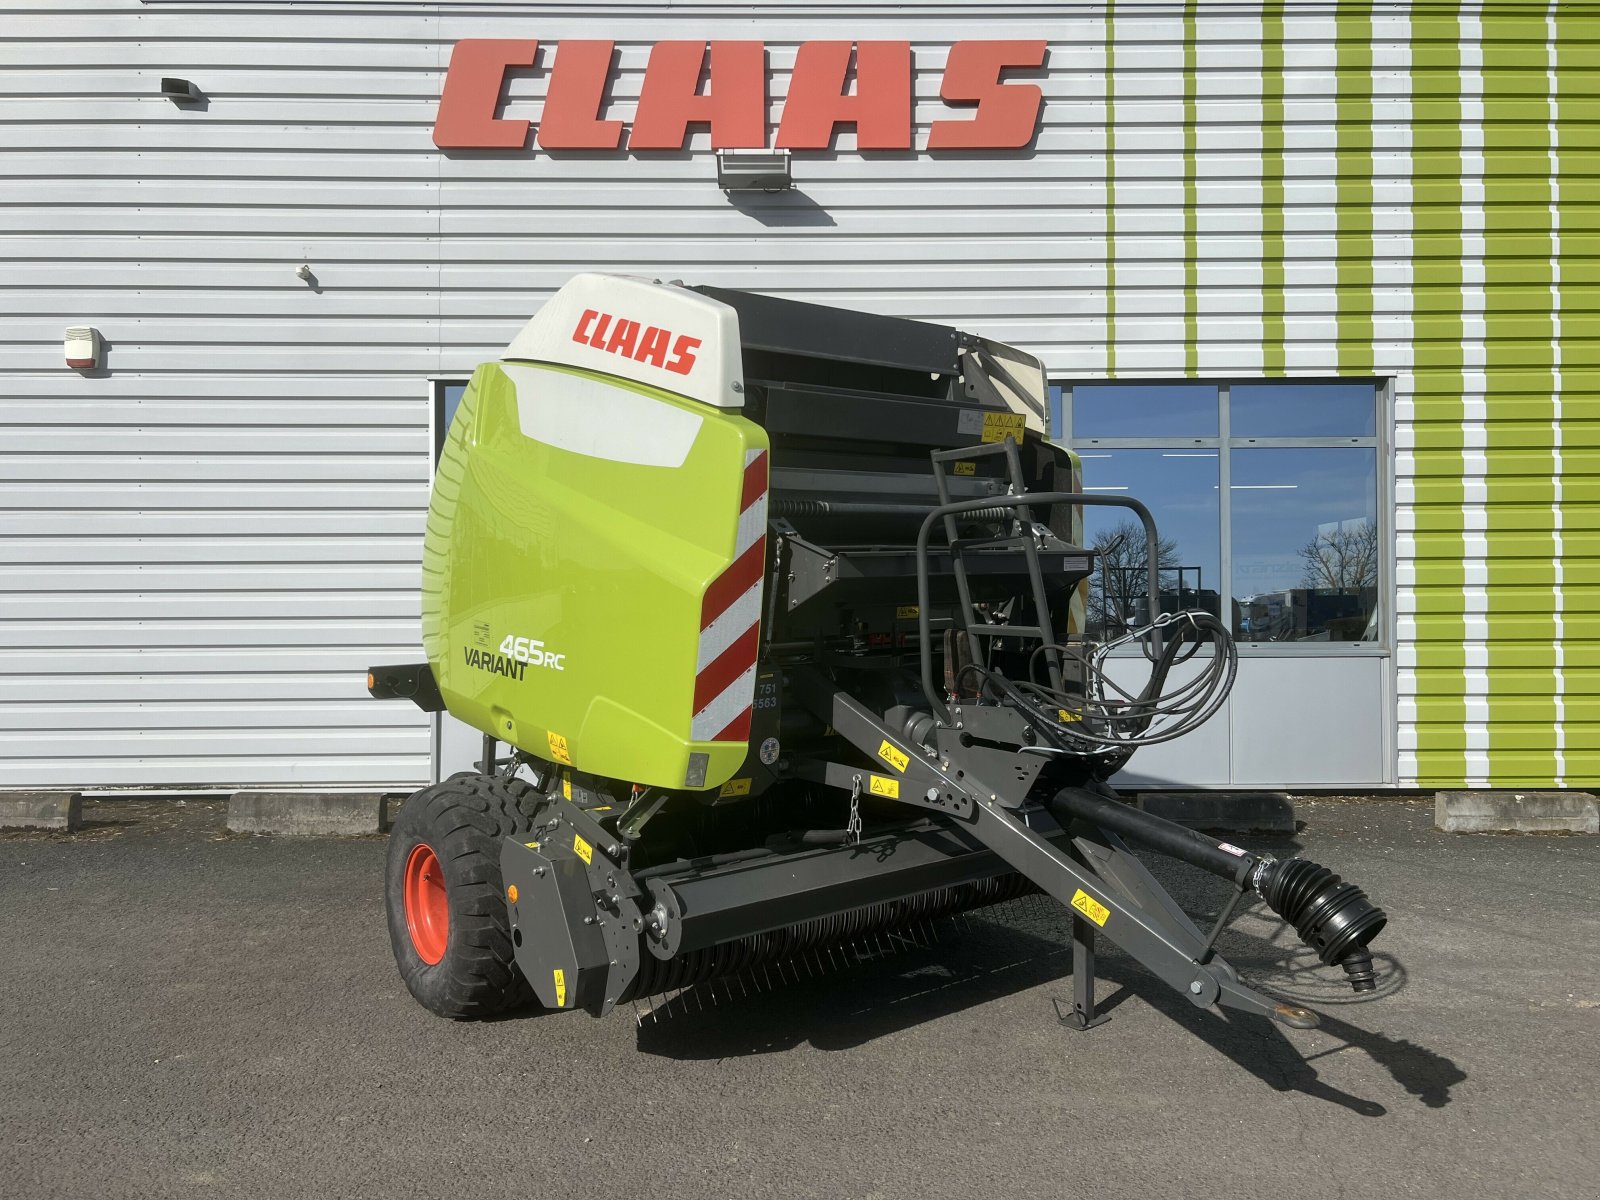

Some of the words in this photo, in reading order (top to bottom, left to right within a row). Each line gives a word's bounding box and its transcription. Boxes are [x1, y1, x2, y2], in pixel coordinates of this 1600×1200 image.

[432, 39, 1048, 151] CLAAS
[572, 308, 703, 376] CLAAS
[464, 646, 529, 682] VARIANT
